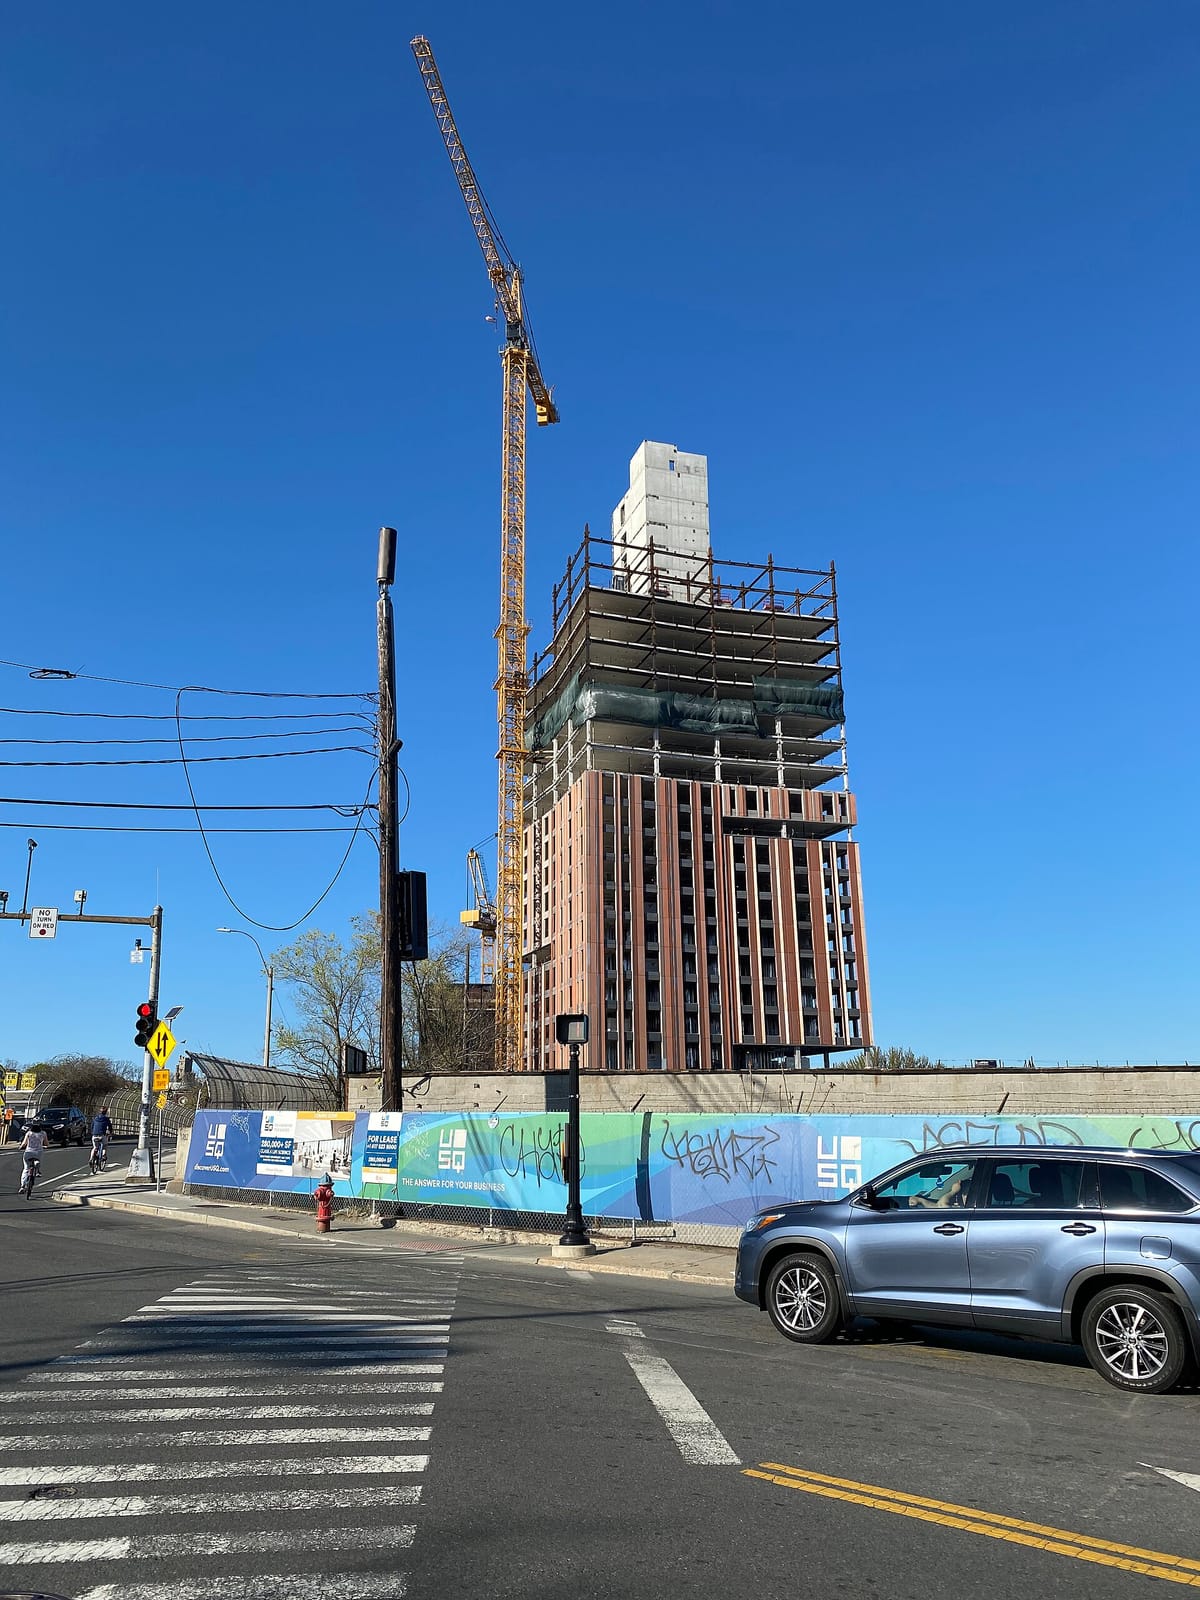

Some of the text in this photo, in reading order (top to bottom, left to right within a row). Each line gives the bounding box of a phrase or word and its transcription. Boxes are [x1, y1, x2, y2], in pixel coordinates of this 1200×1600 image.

[380, 1135, 398, 1143] LEASE
[205, 1141, 225, 1159] SQ
[438, 1151, 465, 1173] SQ
[402, 1178, 505, 1192] THE ANSWER FOR YOUR BUSINESS
[817, 1163, 862, 1192] SQ
